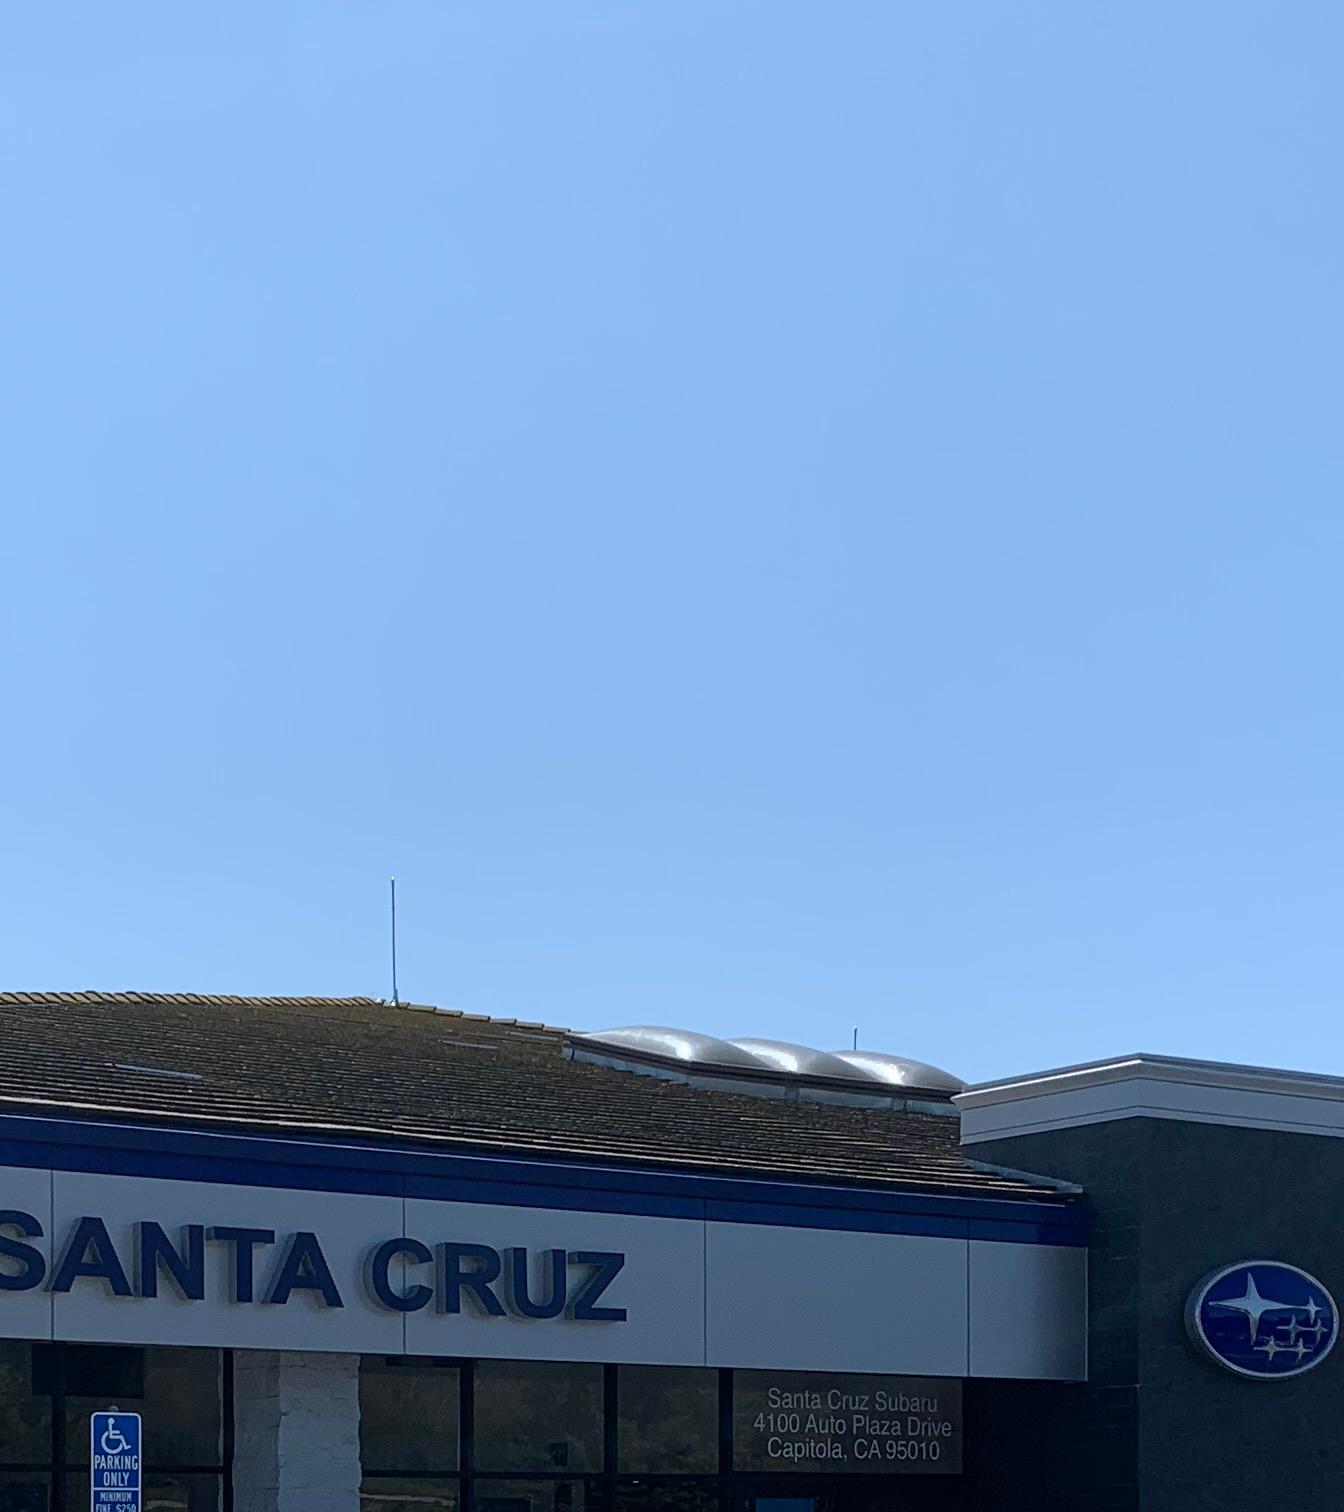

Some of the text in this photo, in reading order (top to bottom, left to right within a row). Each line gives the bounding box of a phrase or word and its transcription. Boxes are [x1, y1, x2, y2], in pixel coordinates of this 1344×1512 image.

[362, 1236, 628, 1322] CRUZ
[767, 1387, 938, 1413] Santa Cruz Subaru
[753, 1412, 953, 1437] 4100 Auto Plaza Drive
[94, 1454, 138, 1470] PARKING
[767, 1436, 941, 1463] Capitola, CA 95010
[103, 1471, 130, 1487] ONLY
[100, 1491, 132, 1502] MINIMUM
